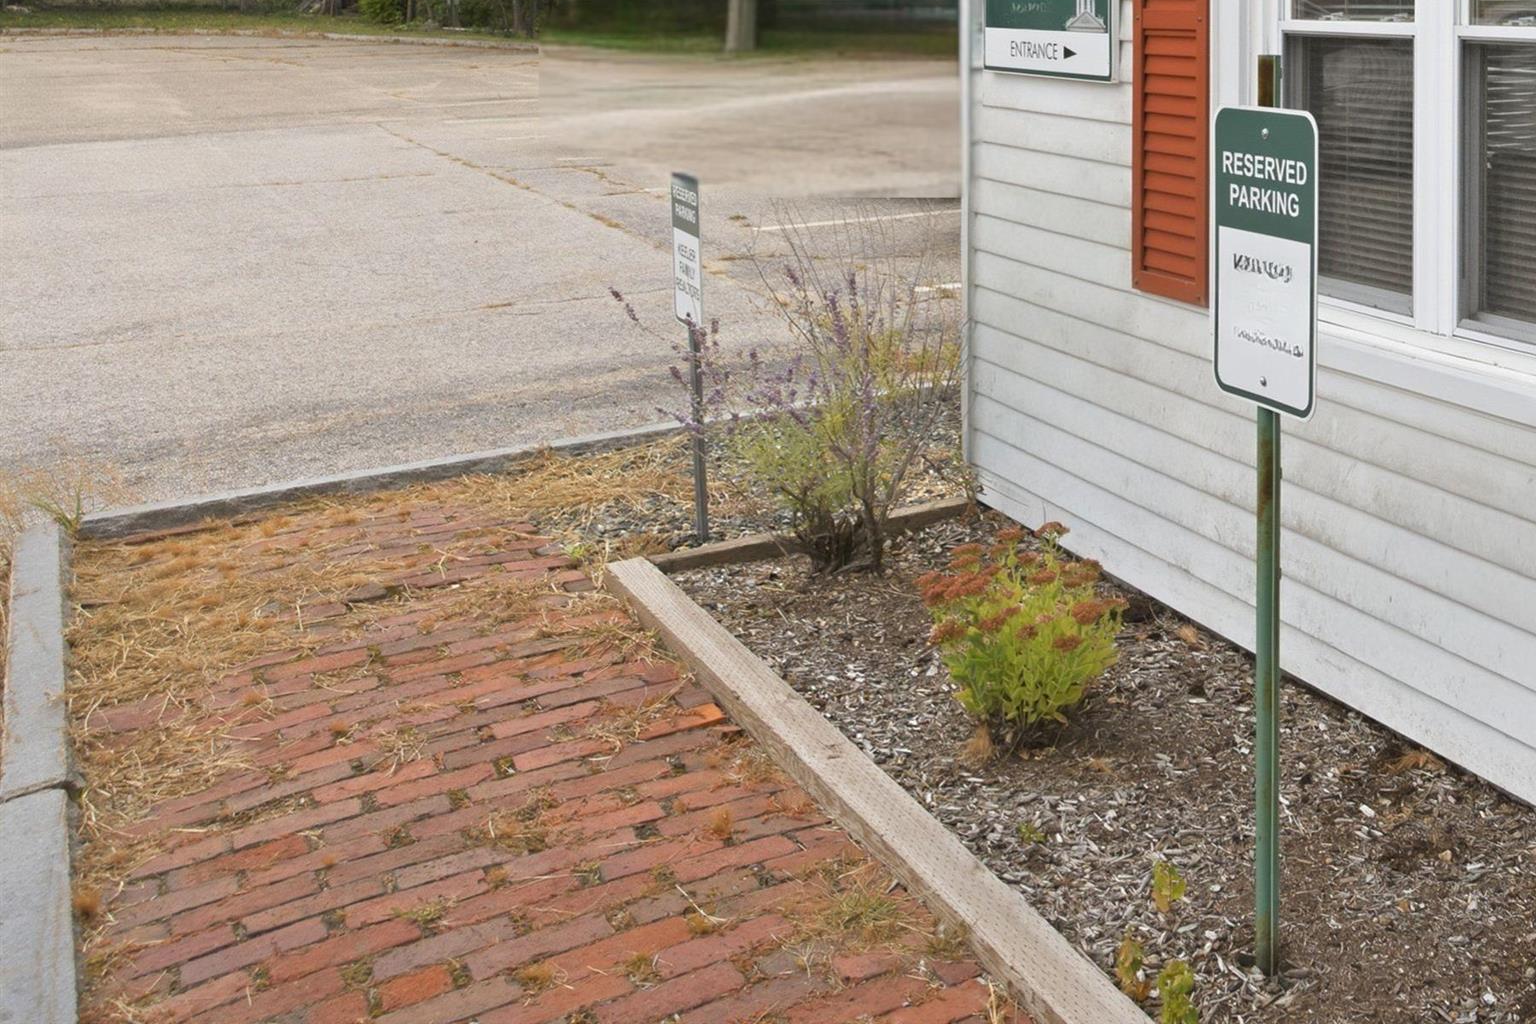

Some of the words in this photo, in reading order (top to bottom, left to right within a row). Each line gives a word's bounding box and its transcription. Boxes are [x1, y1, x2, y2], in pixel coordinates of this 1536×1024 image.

[1010, 40, 1058, 61] ENTRANCE
[1222, 150, 1307, 185] RESERVED
[1229, 183, 1300, 218] PARKING
